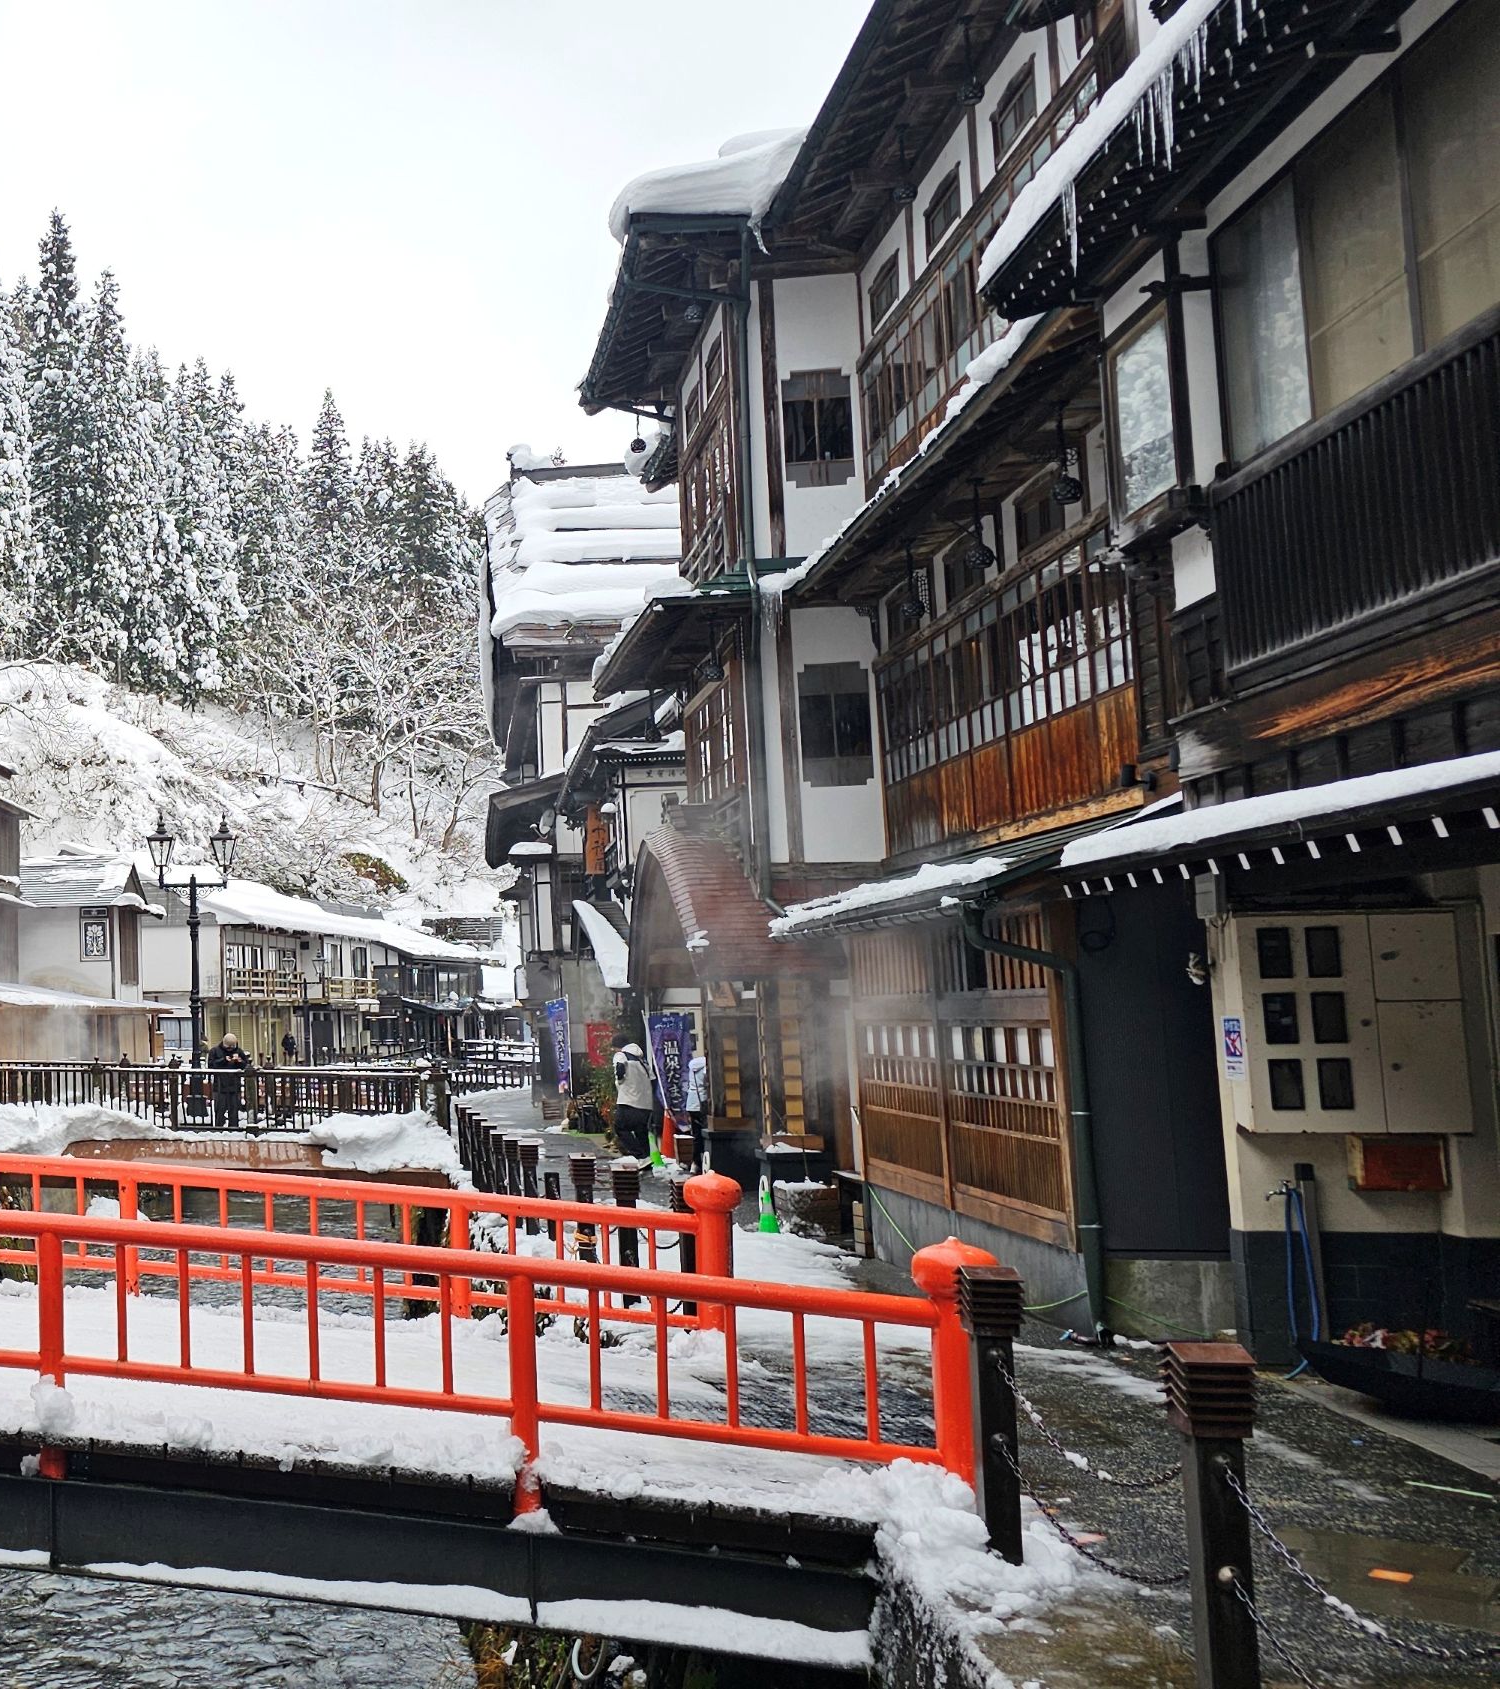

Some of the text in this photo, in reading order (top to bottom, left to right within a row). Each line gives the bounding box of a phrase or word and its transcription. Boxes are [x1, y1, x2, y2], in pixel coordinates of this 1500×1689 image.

[663, 1040, 681, 1112] 温泉たまご
